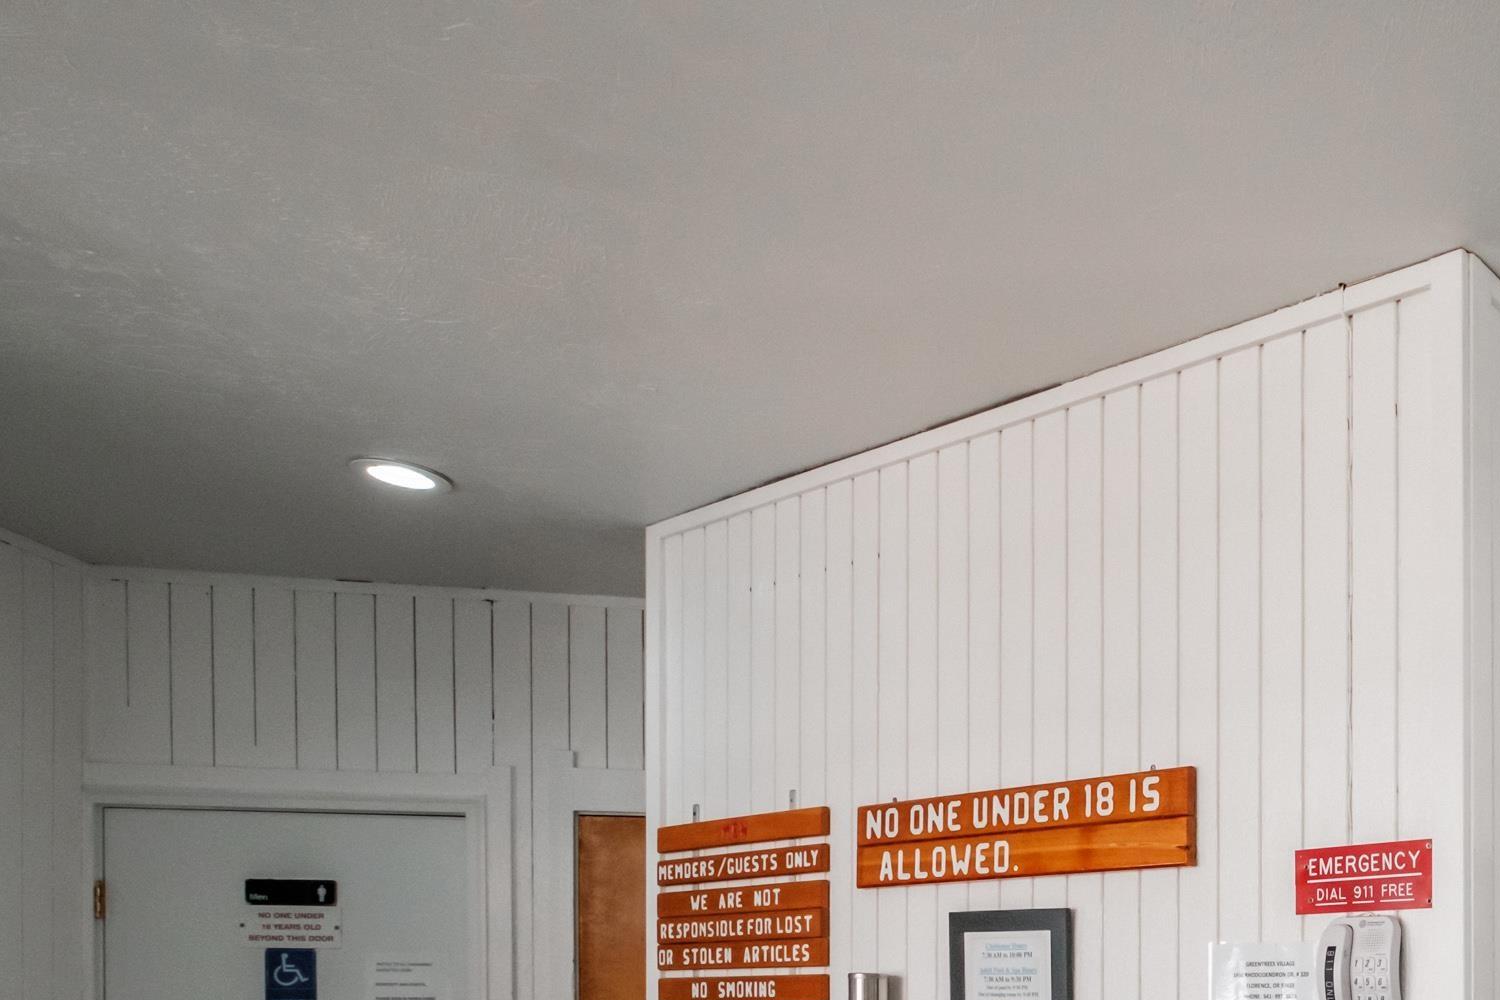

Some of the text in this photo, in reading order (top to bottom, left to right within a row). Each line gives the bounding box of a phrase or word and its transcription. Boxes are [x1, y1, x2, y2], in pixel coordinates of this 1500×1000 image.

[866, 776, 1160, 840] NO ONE UNDER 18 IS
[785, 849, 819, 869] ONLY
[879, 840, 1018, 881] ALLOWED.
[1308, 850, 1421, 876] EMERGENCY
[690, 888, 781, 911] WE ARE NOT
[1316, 883, 1413, 901] DIAL 911 FREE
[294, 912, 324, 920] UNDER
[303, 923, 321, 931] OLD
[660, 915, 813, 940] RESPONSIBLE FOR LOST
[248, 934, 284, 942] BEYOND
[658, 944, 811, 967] OR STOLEN ARTICLES
[691, 980, 776, 998] NO SMOKING
